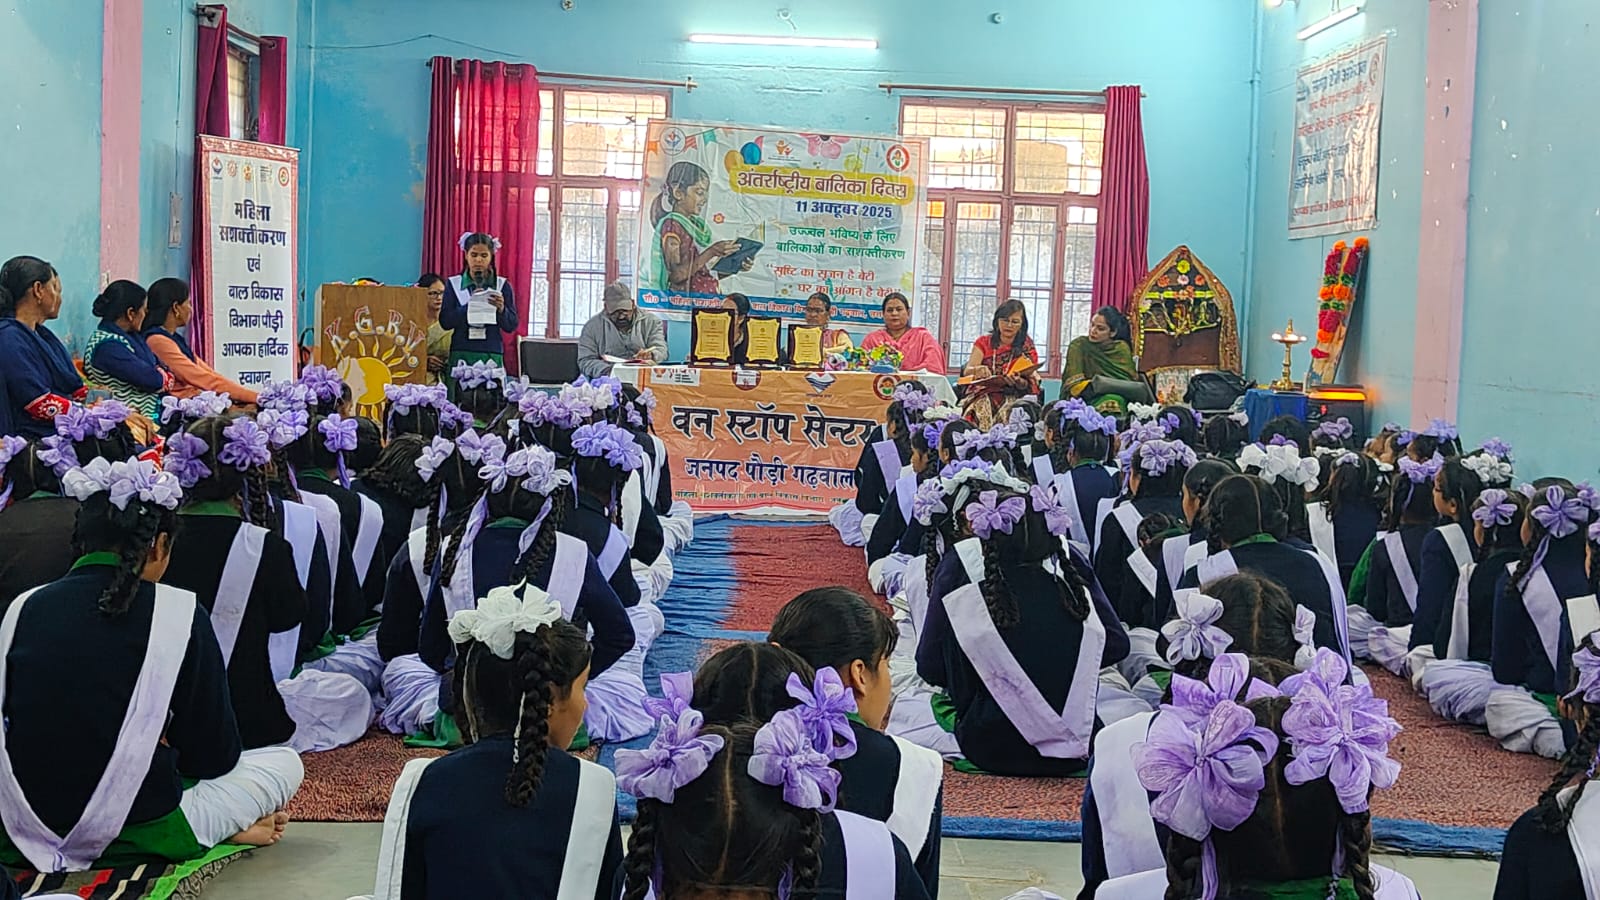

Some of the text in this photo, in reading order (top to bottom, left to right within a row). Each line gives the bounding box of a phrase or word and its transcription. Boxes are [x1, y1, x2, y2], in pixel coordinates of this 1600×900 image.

[737, 168, 907, 198] अंतर्राष्ट्रीय बालिका दिवस
[234, 199, 271, 221] महिला
[796, 200, 892, 218] 11 अक्टूबर 2025
[789, 226, 896, 243] उज्ज्वल भविष्य के लिए
[776, 240, 825, 254] बालिकाओं
[828, 245, 842, 255] का
[246, 254, 261, 272] एवं
[800, 267, 814, 278] का
[817, 269, 844, 281] सृजन
[847, 268, 855, 280] है
[858, 269, 875, 281] बेटी
[251, 281, 284, 301] विकास
[865, 285, 873, 297] है
[229, 308, 260, 328] विभाग
[222, 337, 289, 357] आपका हार्दिक
[671, 402, 876, 448] वन स्टॉप सेन्टर
[684, 454, 856, 489] जनपद पौड़ी गढ़वाल
